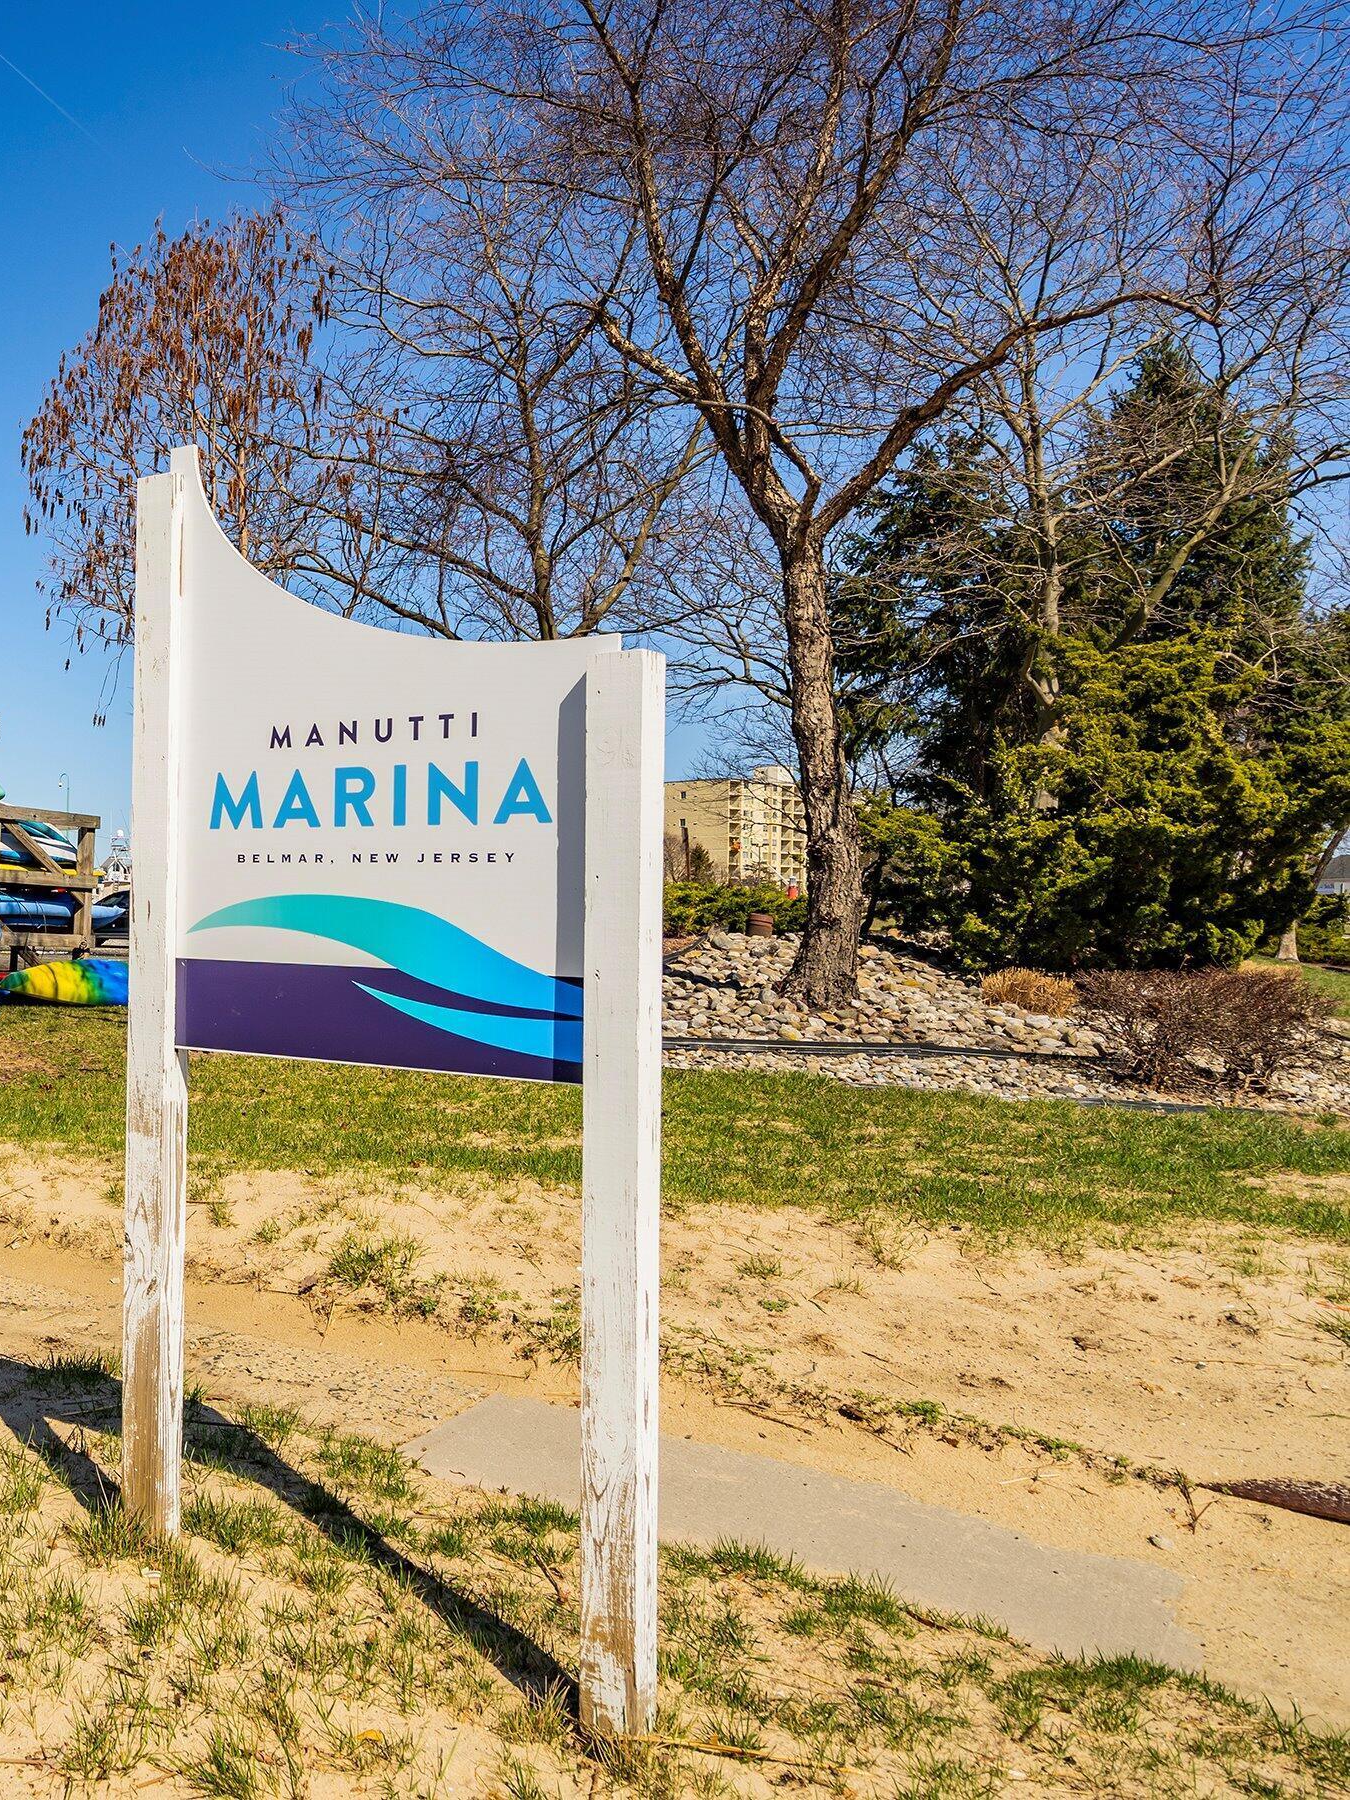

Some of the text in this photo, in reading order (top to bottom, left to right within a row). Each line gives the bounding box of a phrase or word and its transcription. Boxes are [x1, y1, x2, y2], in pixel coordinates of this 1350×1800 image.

[268, 711, 479, 750] MANUTTI
[209, 757, 553, 830] MARINA
[236, 852, 516, 864] BELMAR, NEW JERSEY
